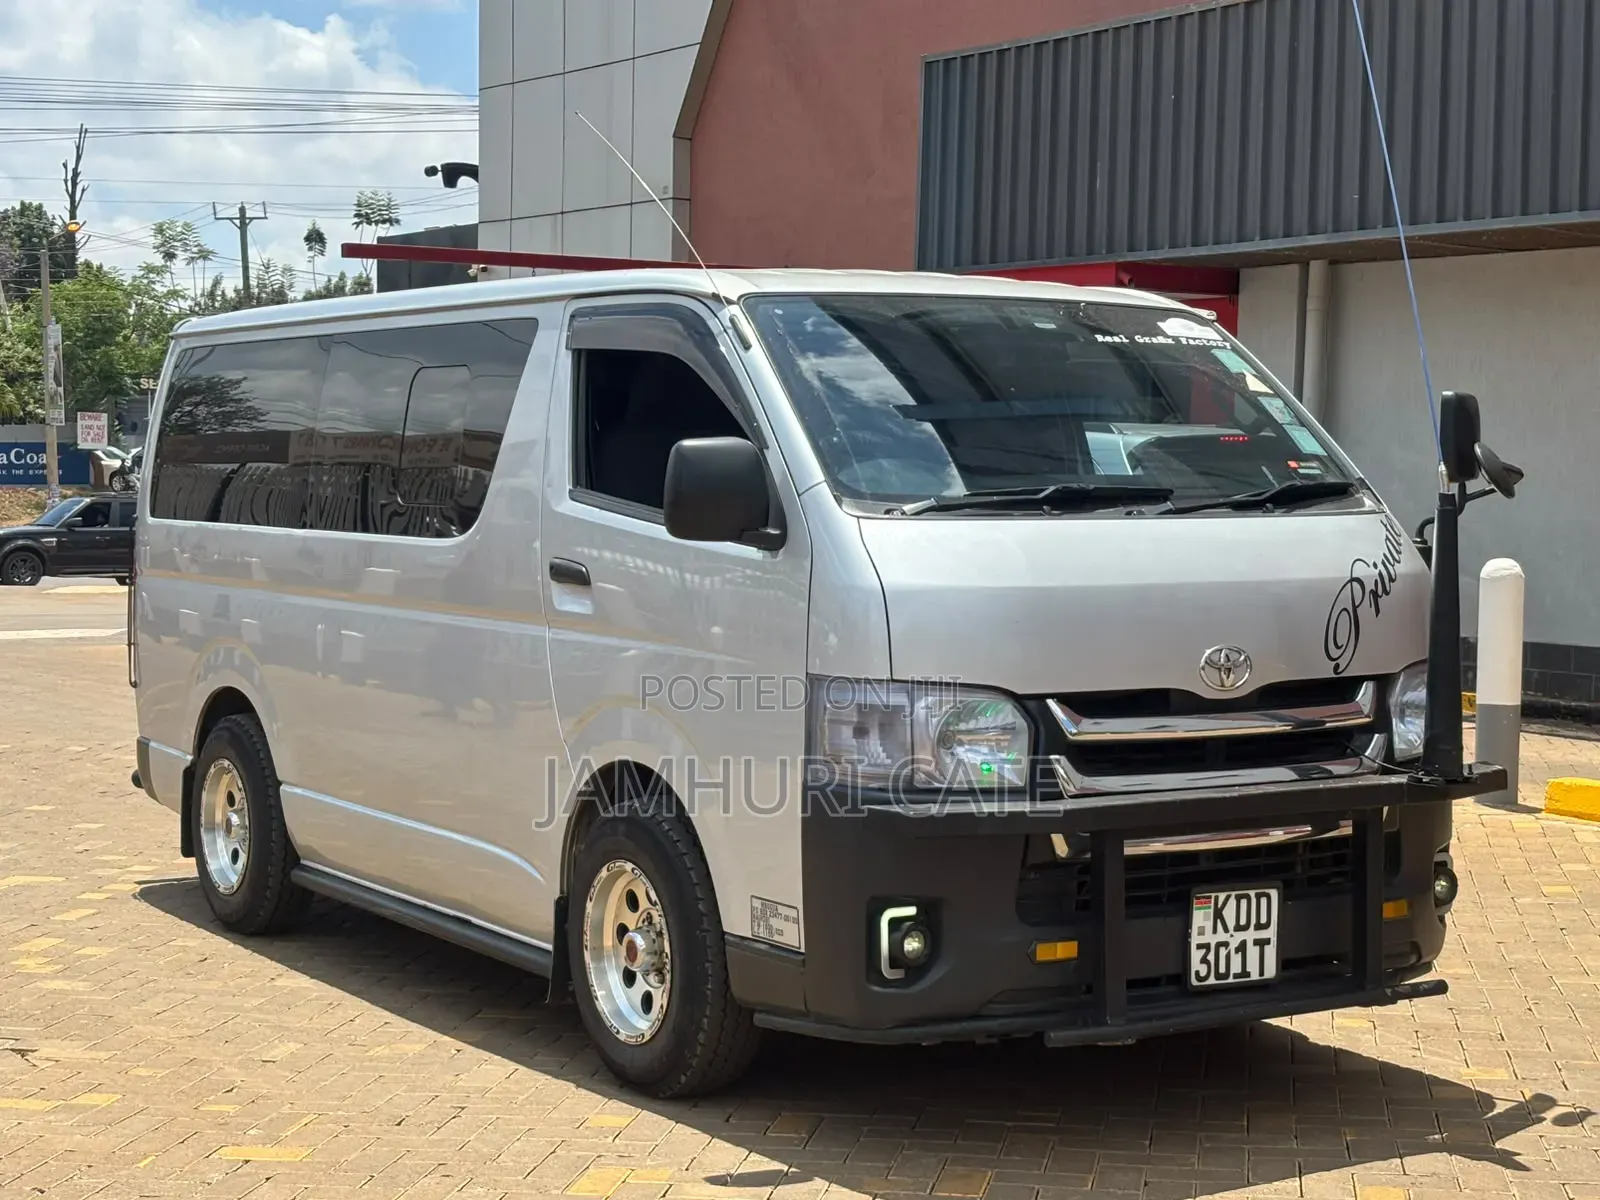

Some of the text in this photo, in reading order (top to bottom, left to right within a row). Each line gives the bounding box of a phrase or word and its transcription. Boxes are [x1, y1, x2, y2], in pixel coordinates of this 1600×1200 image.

[1094, 334, 1130, 343] Real
[1179, 337, 1232, 349] Factory
[80, 413, 104, 421] BEWARE
[0, 448, 47, 464] aCoa
[1212, 891, 1272, 934] KDD
[1194, 938, 1271, 983] 301T
